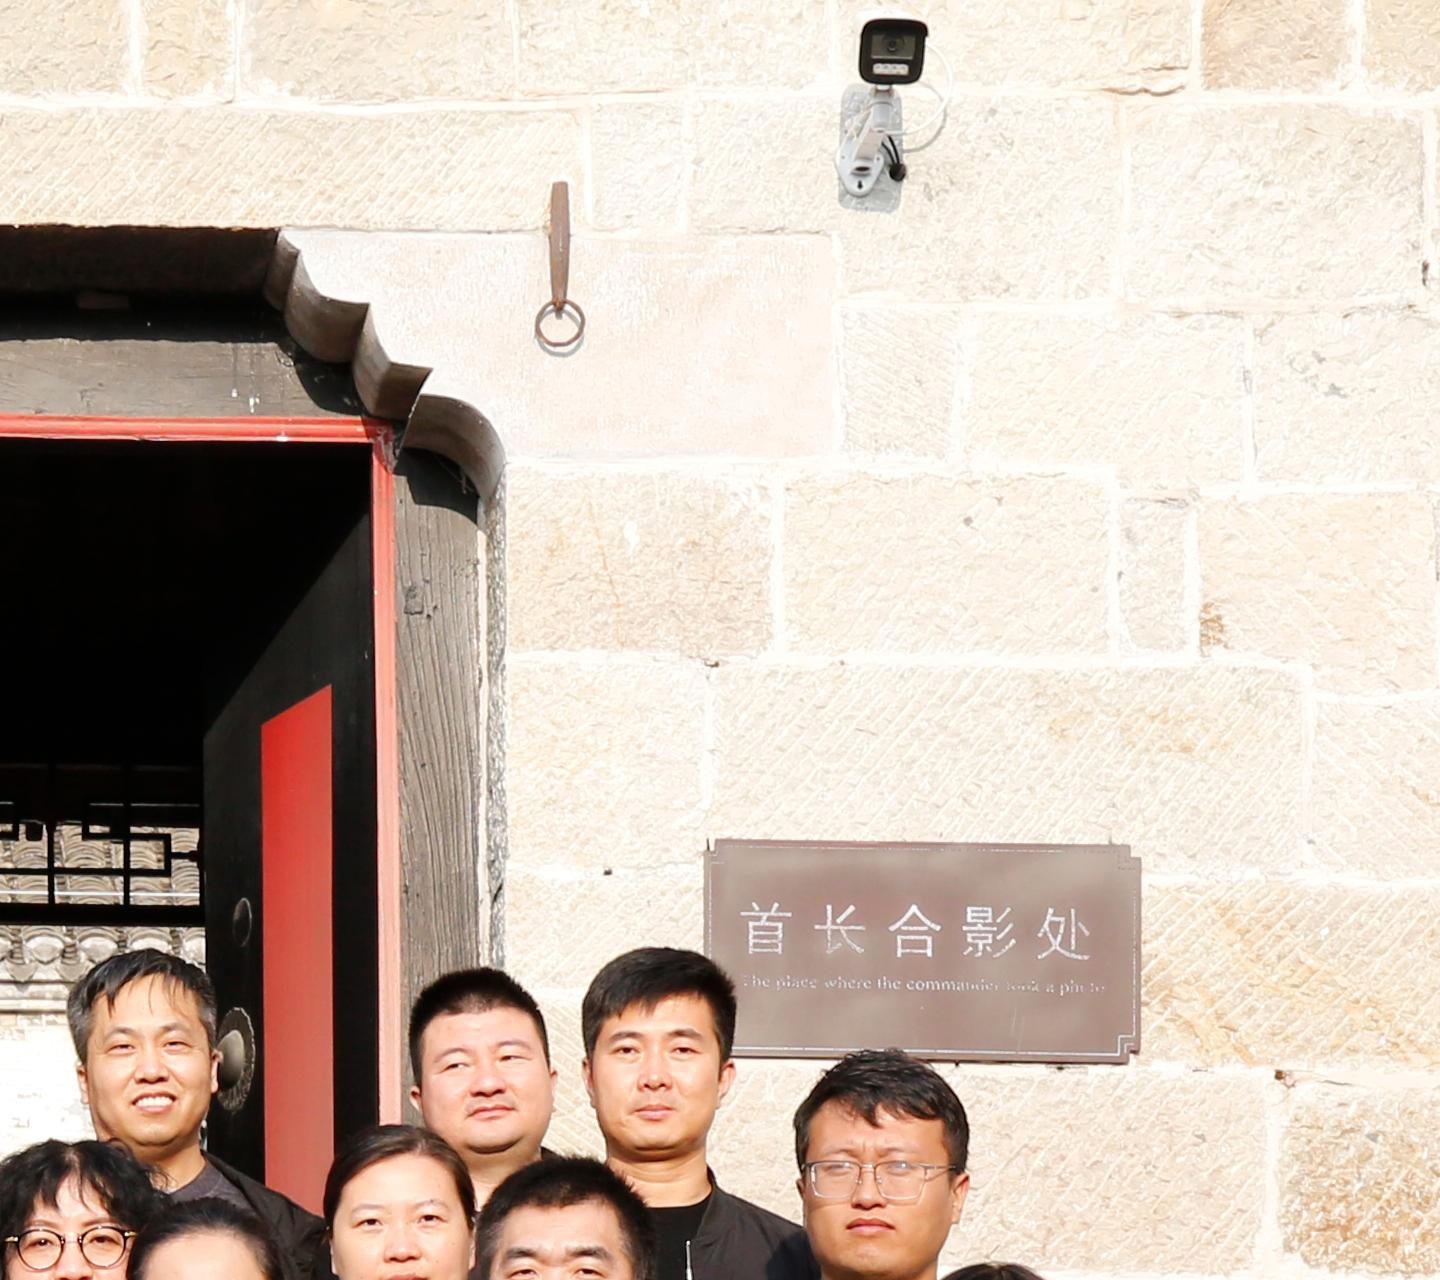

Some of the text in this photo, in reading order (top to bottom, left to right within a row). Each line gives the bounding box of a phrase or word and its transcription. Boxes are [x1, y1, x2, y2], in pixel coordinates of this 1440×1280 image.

[740, 901, 1090, 961] 首长合影处
[877, 975, 901, 990] the
